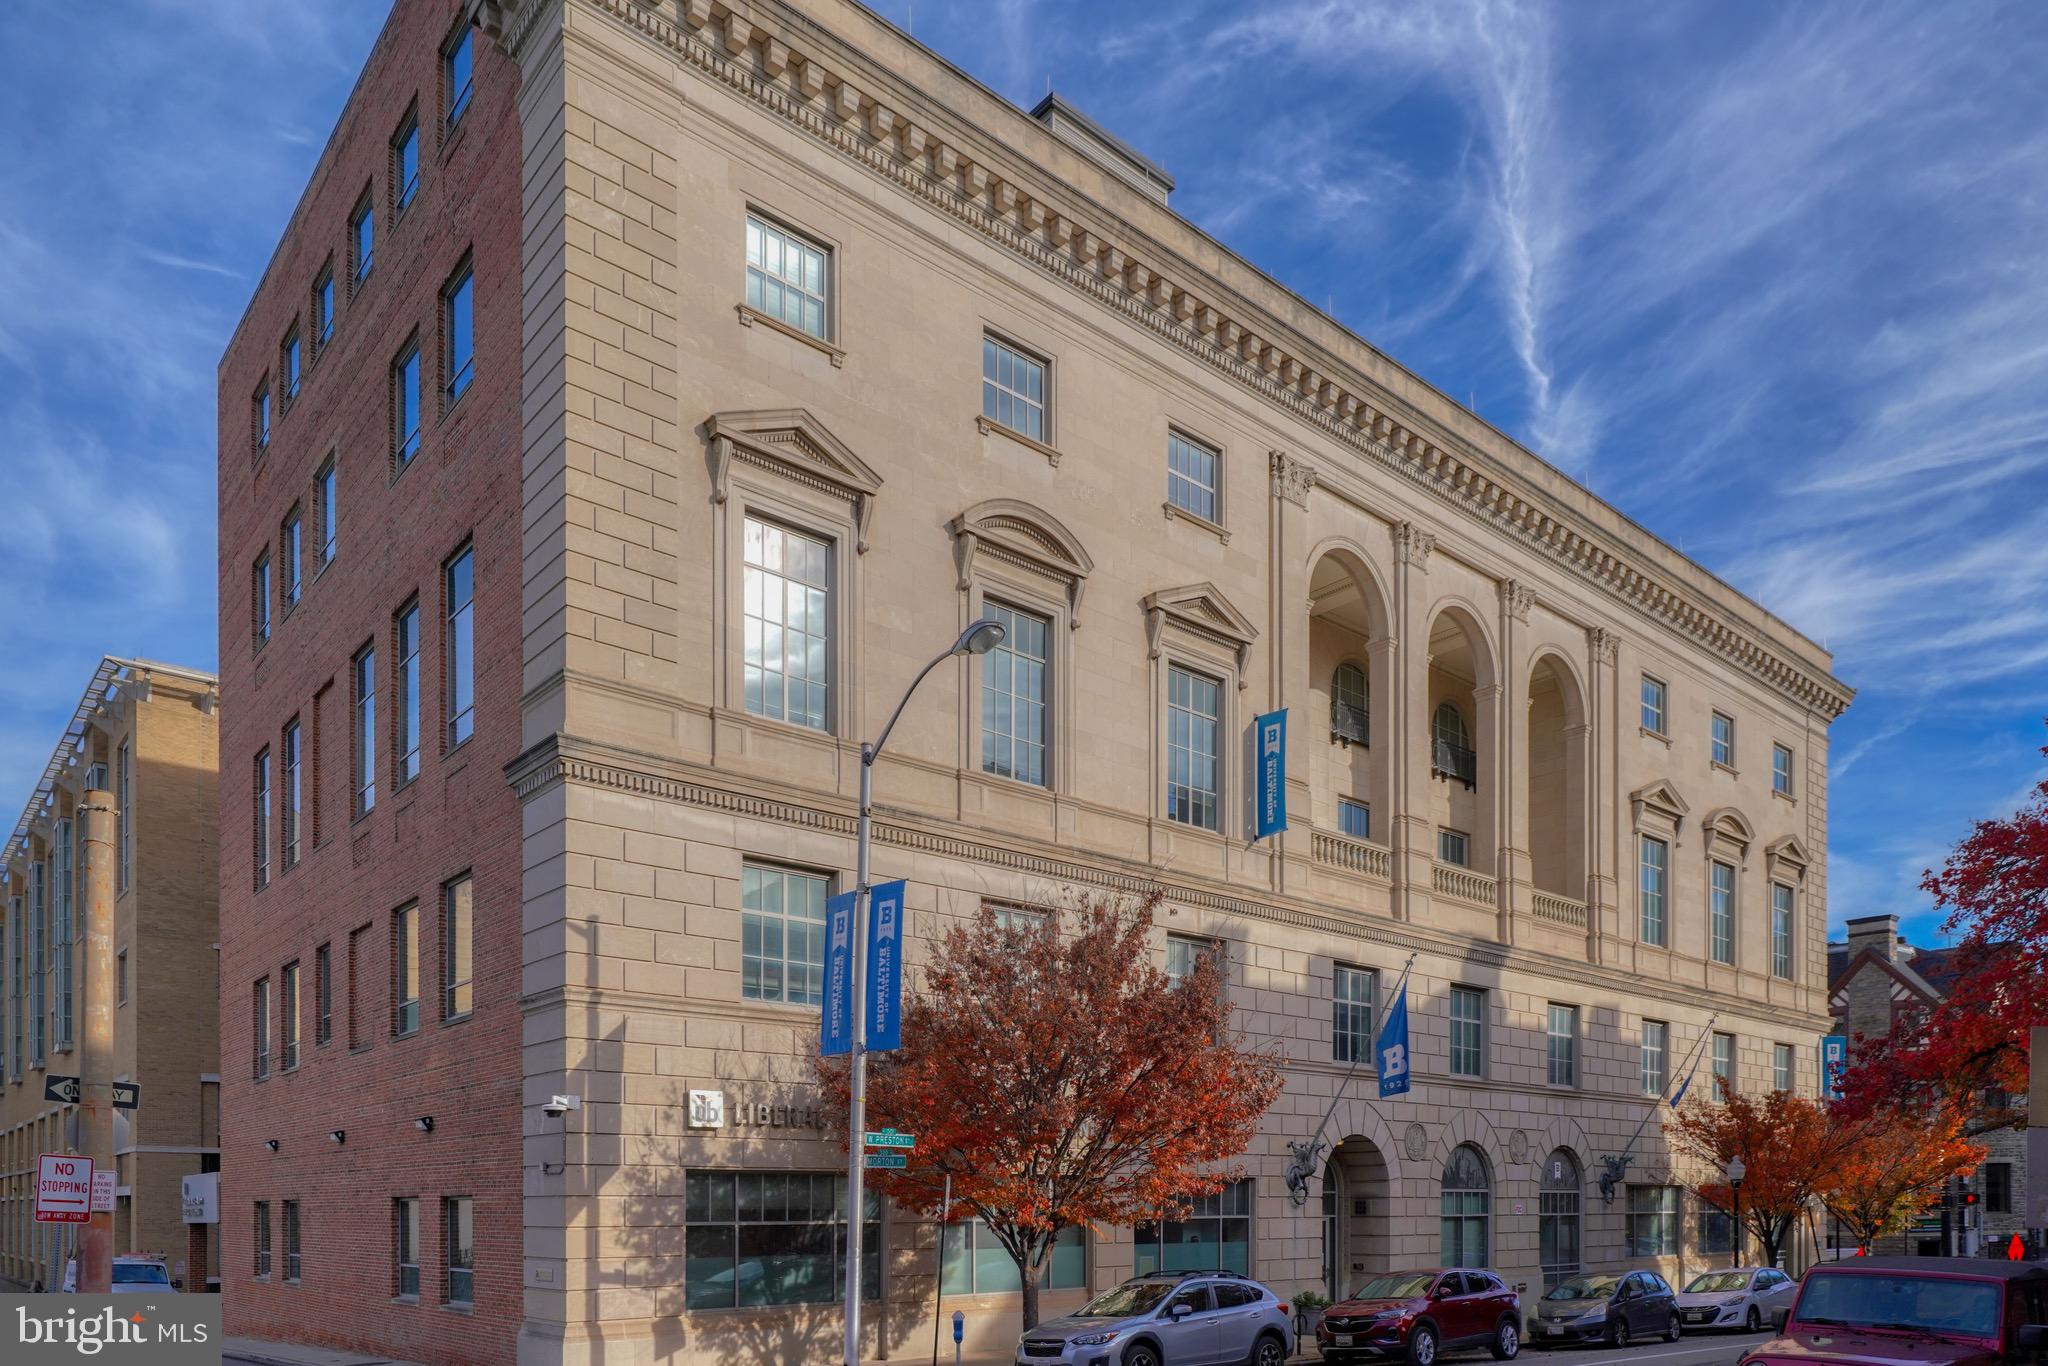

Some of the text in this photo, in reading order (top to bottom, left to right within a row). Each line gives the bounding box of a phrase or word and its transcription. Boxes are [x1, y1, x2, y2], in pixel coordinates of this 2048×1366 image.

[1267, 729, 1277, 743] B
[881, 906, 892, 924] B
[836, 916, 845, 934] B
[876, 947, 887, 1033] BALTIMORE
[831, 956, 842, 1039] BALTIMORE
[1383, 1044, 1407, 1079] B
[63, 1084, 80, 1096] ON
[875, 1136, 904, 1145] PRESTON
[867, 1157, 895, 1167] MORTON
[55, 1163, 75, 1176] NO
[41, 1180, 88, 1194] STOPPING
